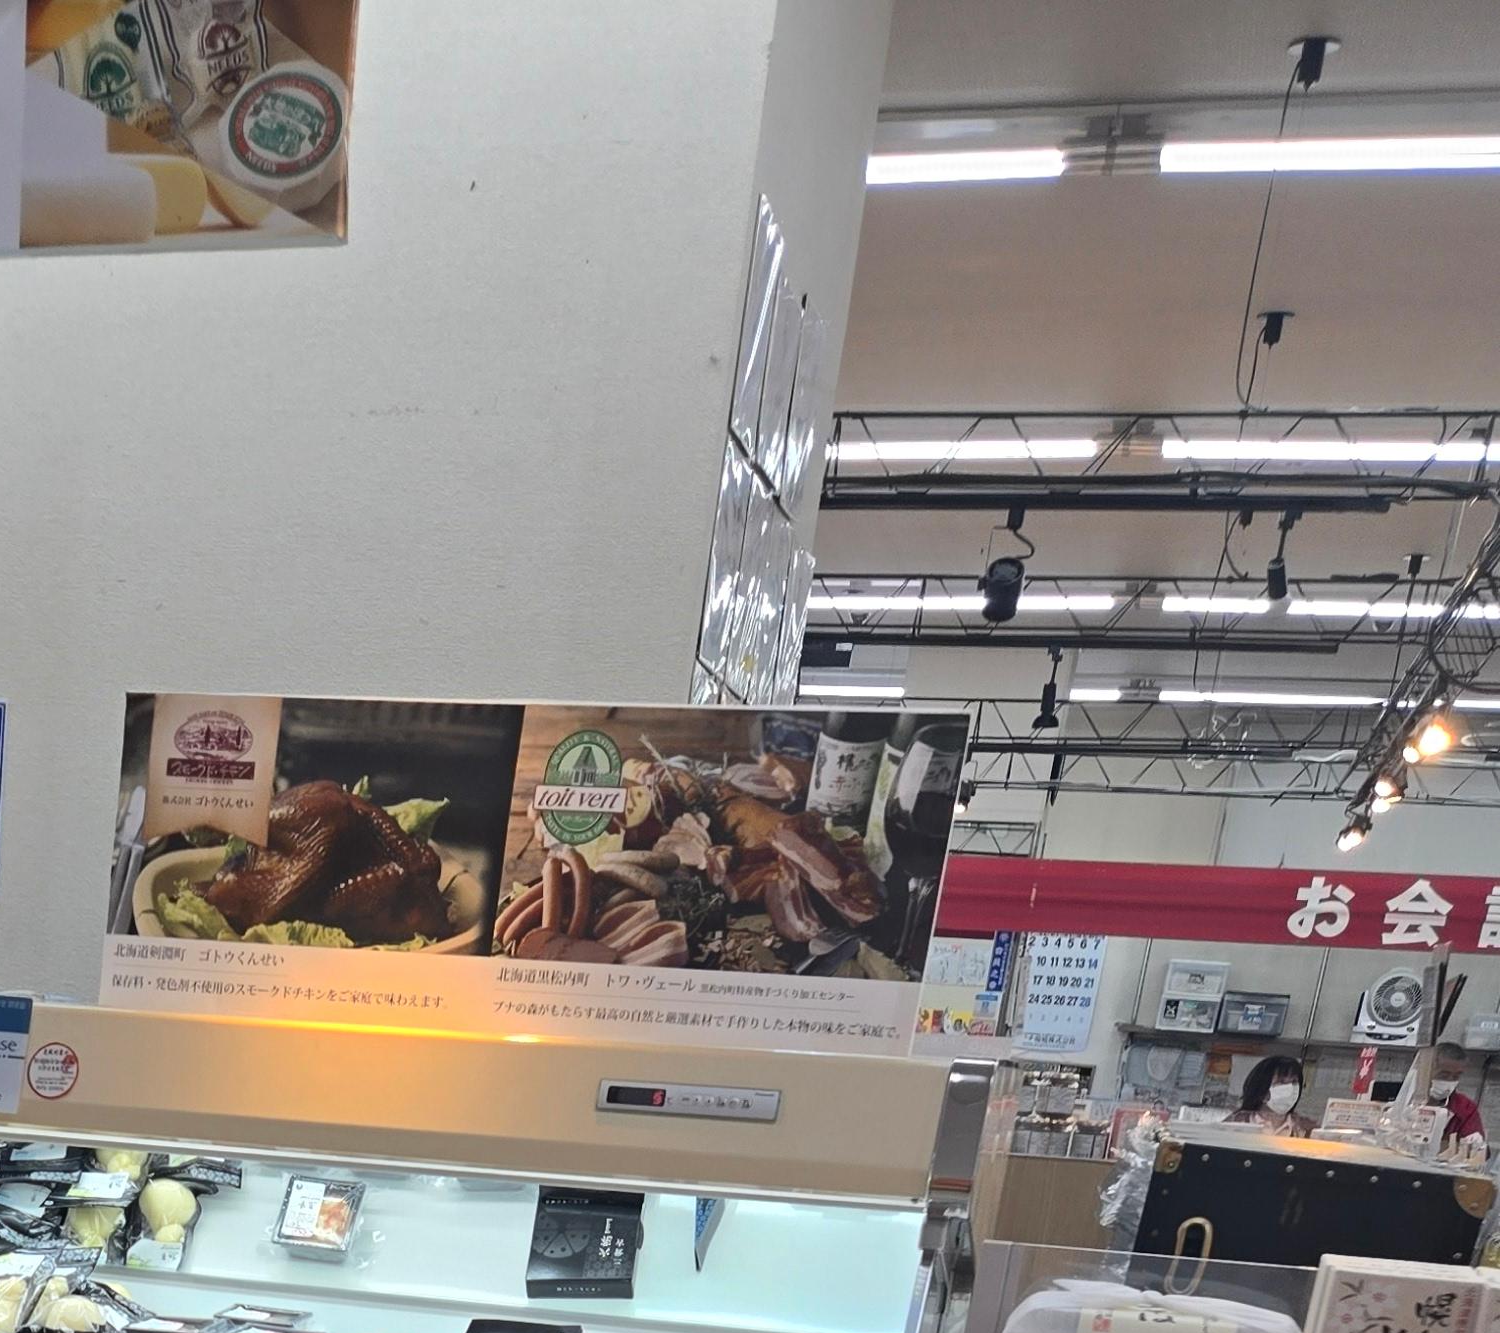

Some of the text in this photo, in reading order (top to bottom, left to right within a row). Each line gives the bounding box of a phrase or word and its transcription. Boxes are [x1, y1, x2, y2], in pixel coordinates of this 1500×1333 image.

[196, 796, 254, 809] ゴトウくんせい
[537, 787, 620, 810] toit vert
[1028, 936, 1101, 950] 2 3 4 5 6 7
[113, 943, 286, 968] 北海道剣淵町 ゴトウくんせい
[1037, 956, 1098, 970] 10 11 12 13 14
[496, 966, 589, 988] 北海道黒松内町
[605, 972, 696, 993] トワ・ヴェール
[1033, 975, 1095, 988] 17 18 19 20 21
[1028, 994, 1091, 1007] 24 25 26 27 28
